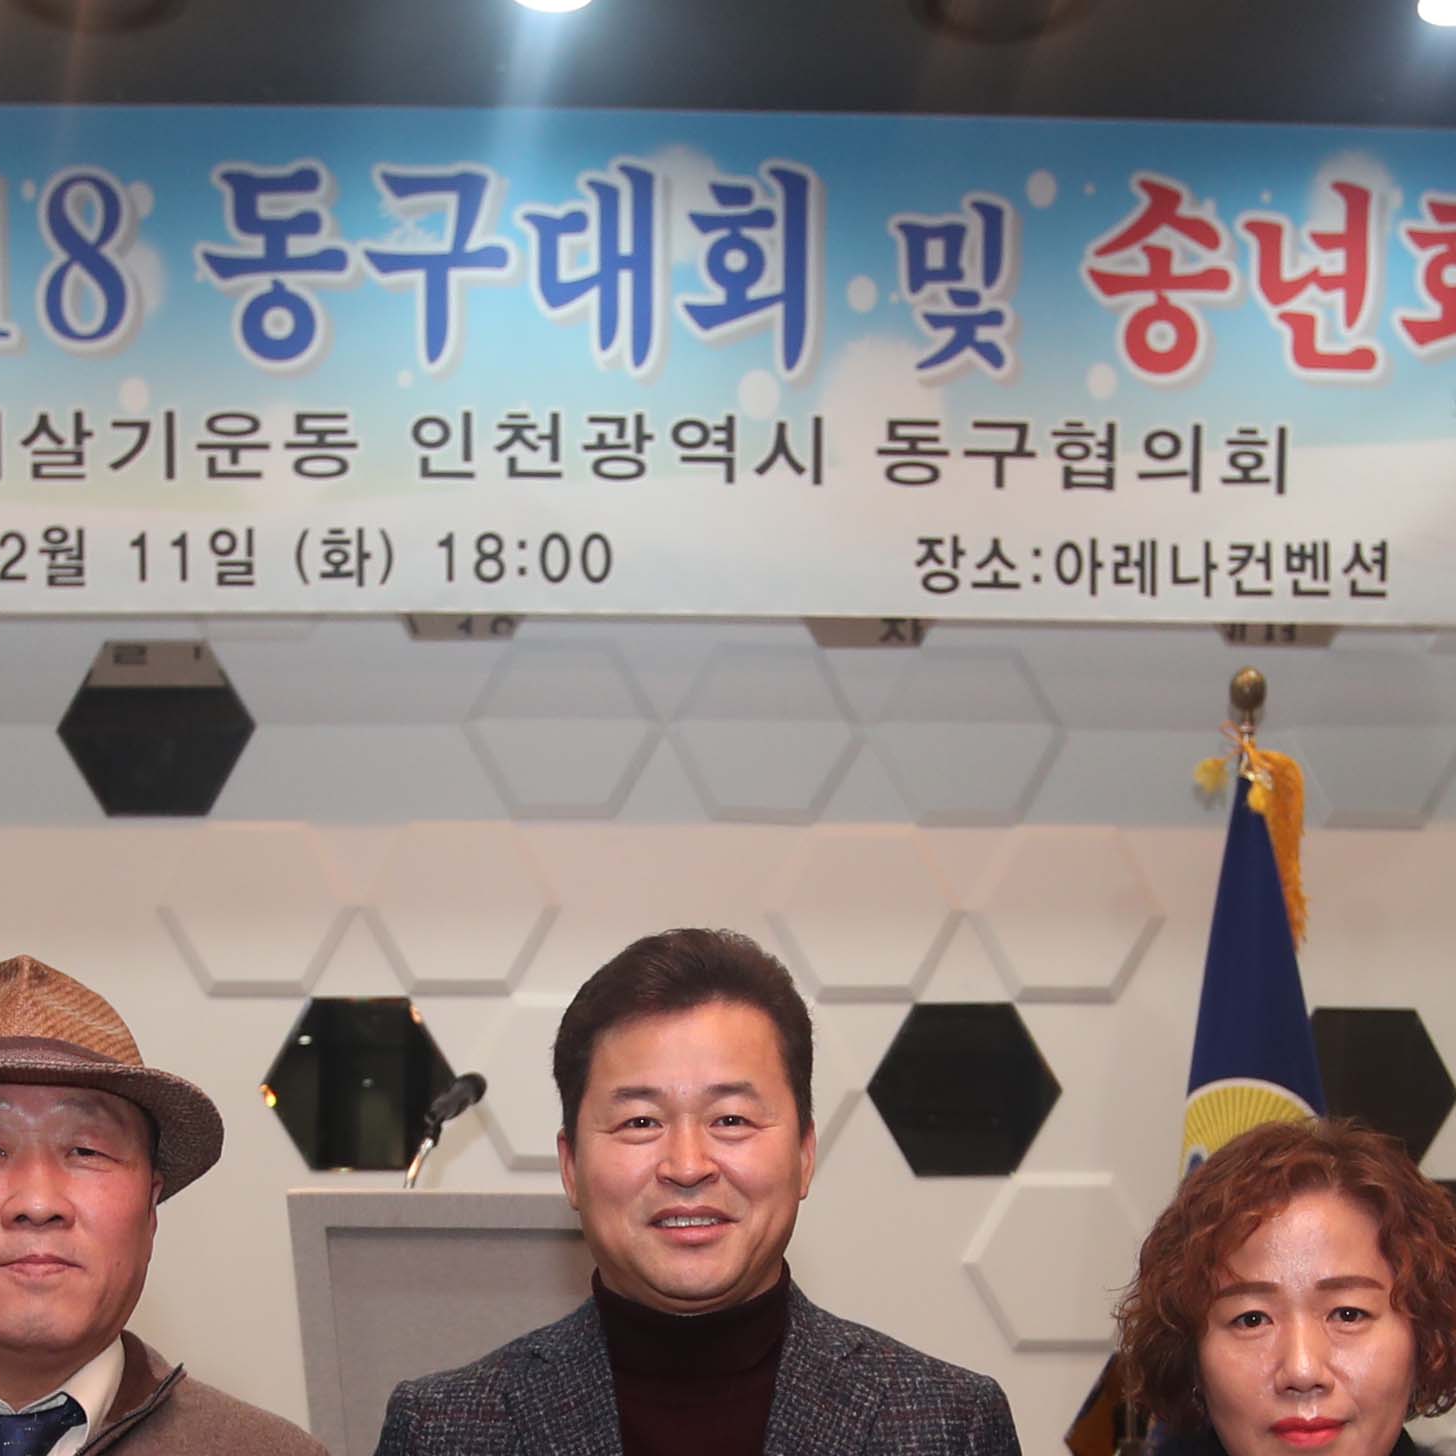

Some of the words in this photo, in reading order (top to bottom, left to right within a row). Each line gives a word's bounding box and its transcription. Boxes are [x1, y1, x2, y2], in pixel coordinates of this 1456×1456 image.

[199, 162, 819, 376] 동구대회
[892, 198, 1014, 376] 및
[409, 411, 827, 489] 인천광역시
[876, 418, 1294, 496] 동구협의회
[129, 531, 257, 590] 11일
[294, 530, 396, 590] (화)
[436, 533, 616, 587] 18:00
[913, 535, 1393, 600] 장소:아레나컨벤션
